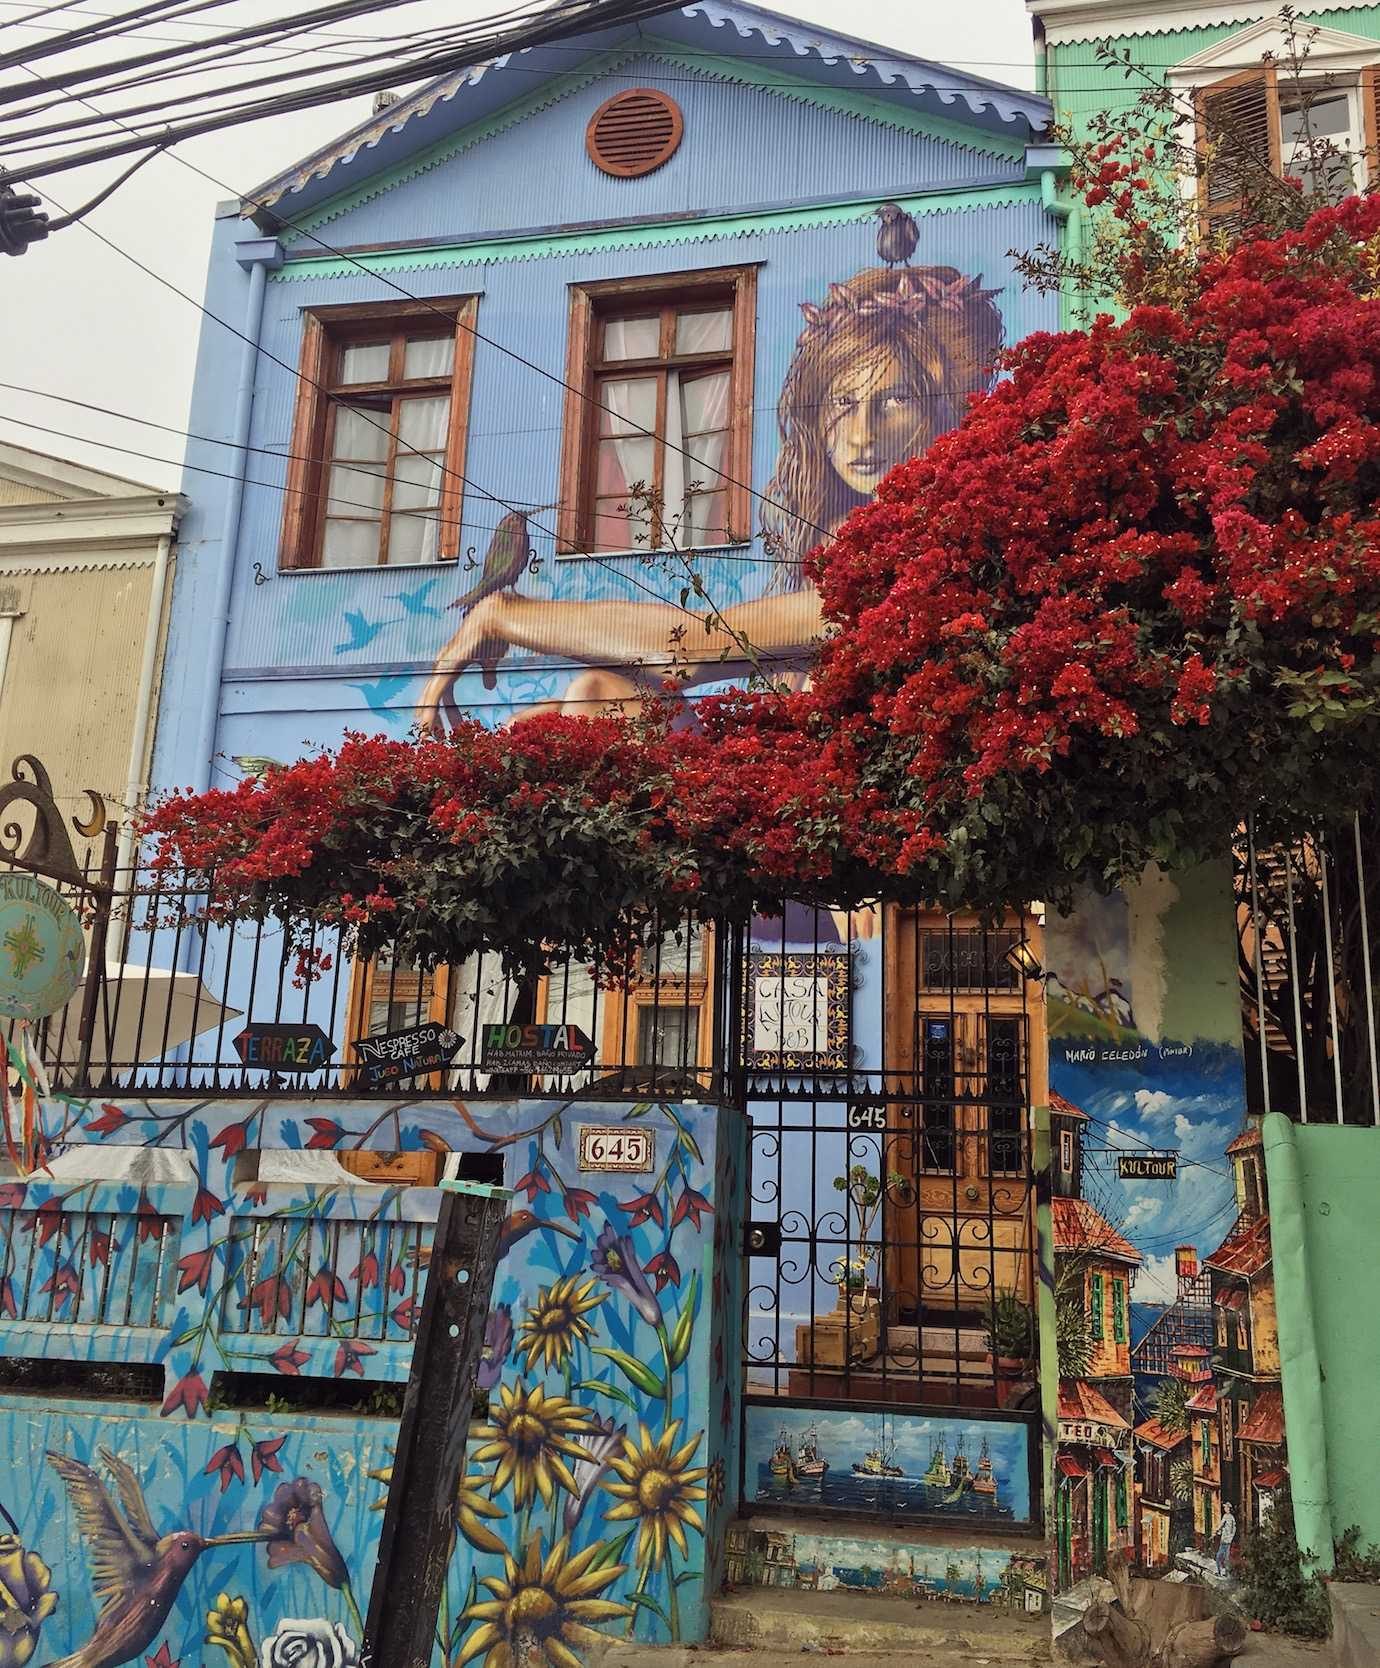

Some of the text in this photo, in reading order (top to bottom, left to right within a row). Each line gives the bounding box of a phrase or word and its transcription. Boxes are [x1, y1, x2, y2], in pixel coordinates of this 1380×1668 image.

[759, 978, 824, 998] CASA
[239, 1033, 324, 1065] TERRAZA
[358, 1028, 436, 1062] NESPRESSO
[486, 1025, 584, 1053] HOSTAL
[390, 1044, 421, 1060] CAFE
[848, 1105, 886, 1129] 645
[591, 1137, 641, 1161] 645
[1119, 1158, 1176, 1177] KULTOUR
